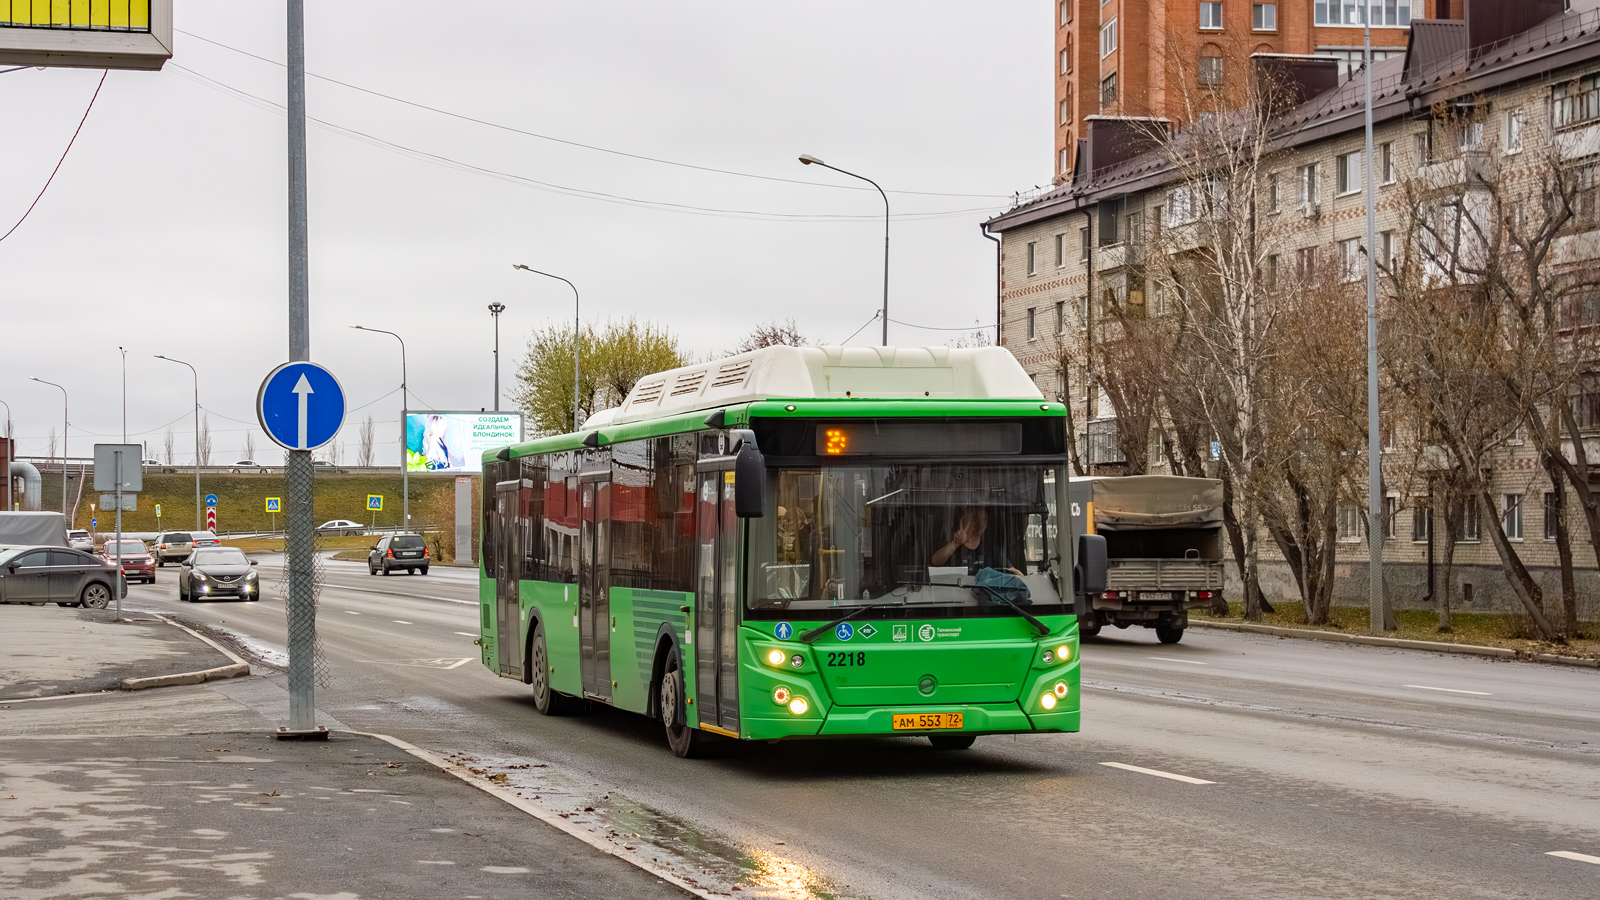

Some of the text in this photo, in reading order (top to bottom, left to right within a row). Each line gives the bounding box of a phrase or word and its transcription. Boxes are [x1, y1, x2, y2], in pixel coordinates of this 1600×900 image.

[827, 651, 866, 667] 2218
[899, 713, 959, 728] АМ 553 72
